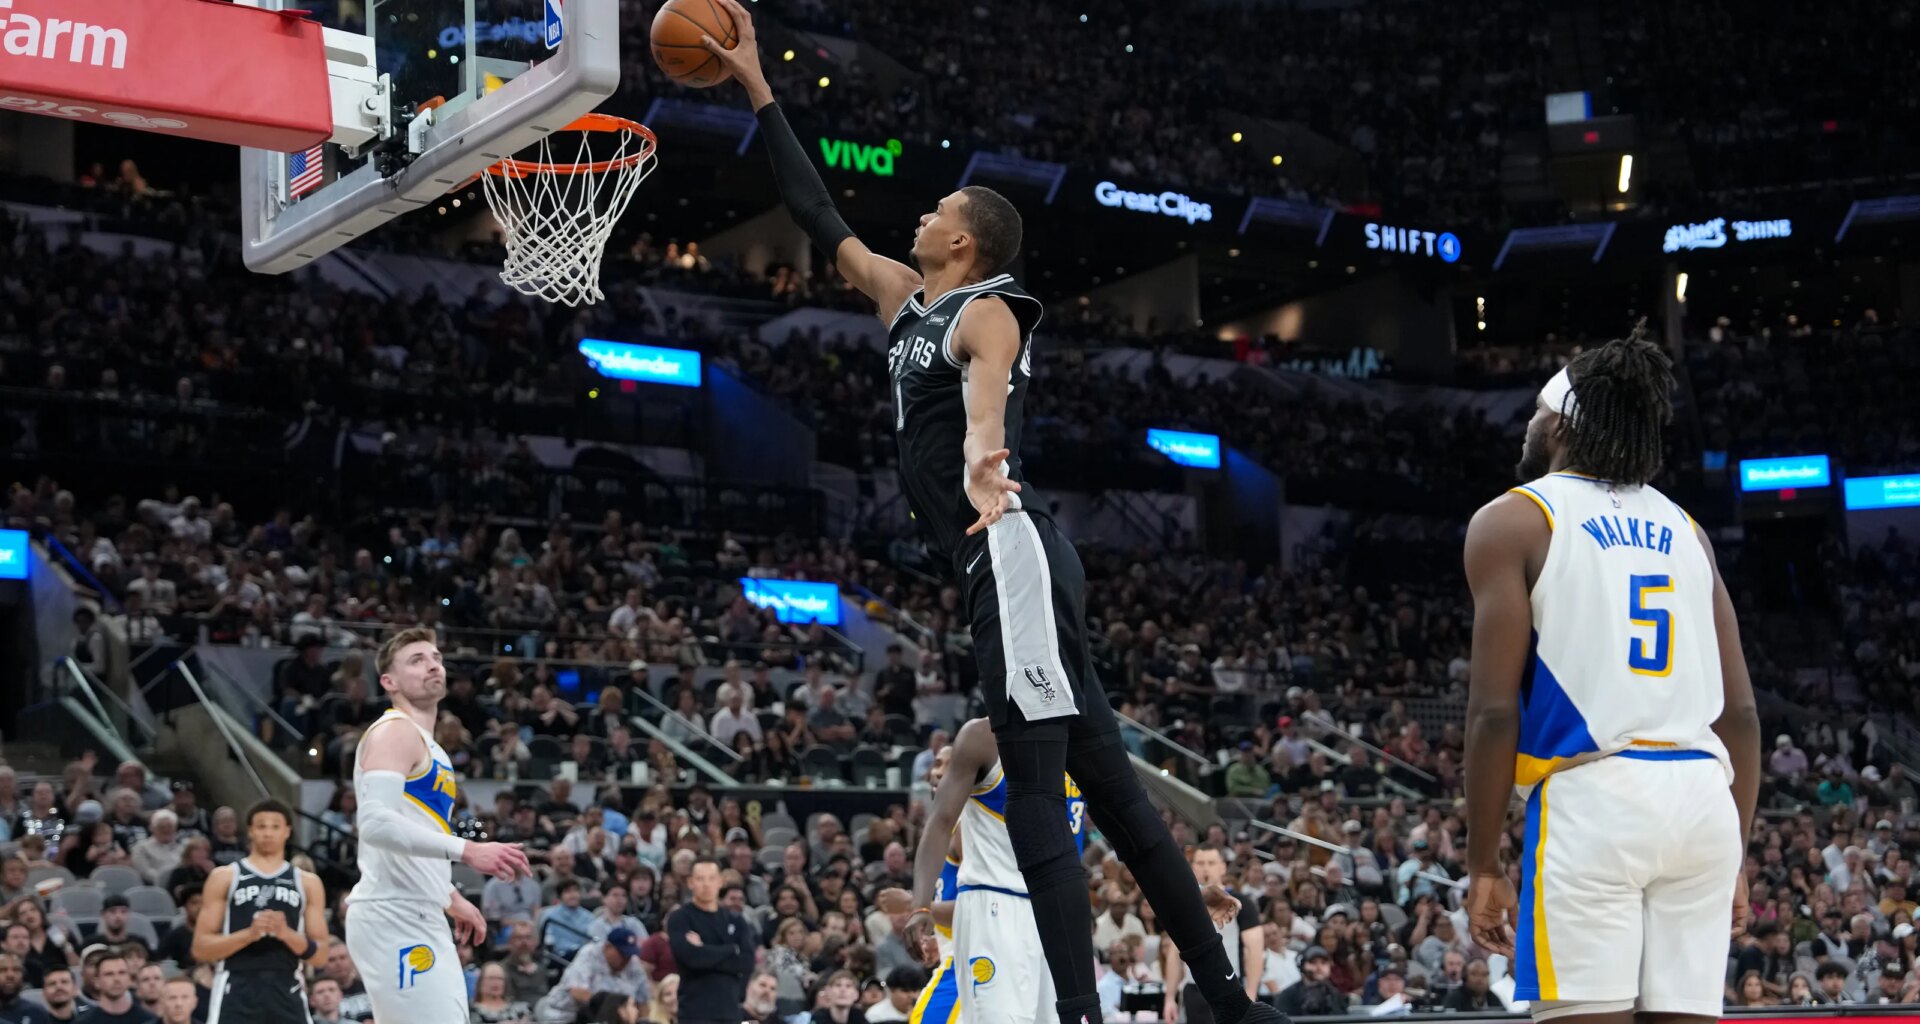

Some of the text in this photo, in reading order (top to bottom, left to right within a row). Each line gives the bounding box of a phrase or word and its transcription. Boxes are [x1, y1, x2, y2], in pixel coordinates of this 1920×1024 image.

[548, 20, 561, 42] NBA
[1095, 181, 1213, 225] Great Clips
[1364, 222, 1437, 258] SHIFT
[1581, 514, 1674, 556] WALKER
[1628, 573, 1676, 678] 5
